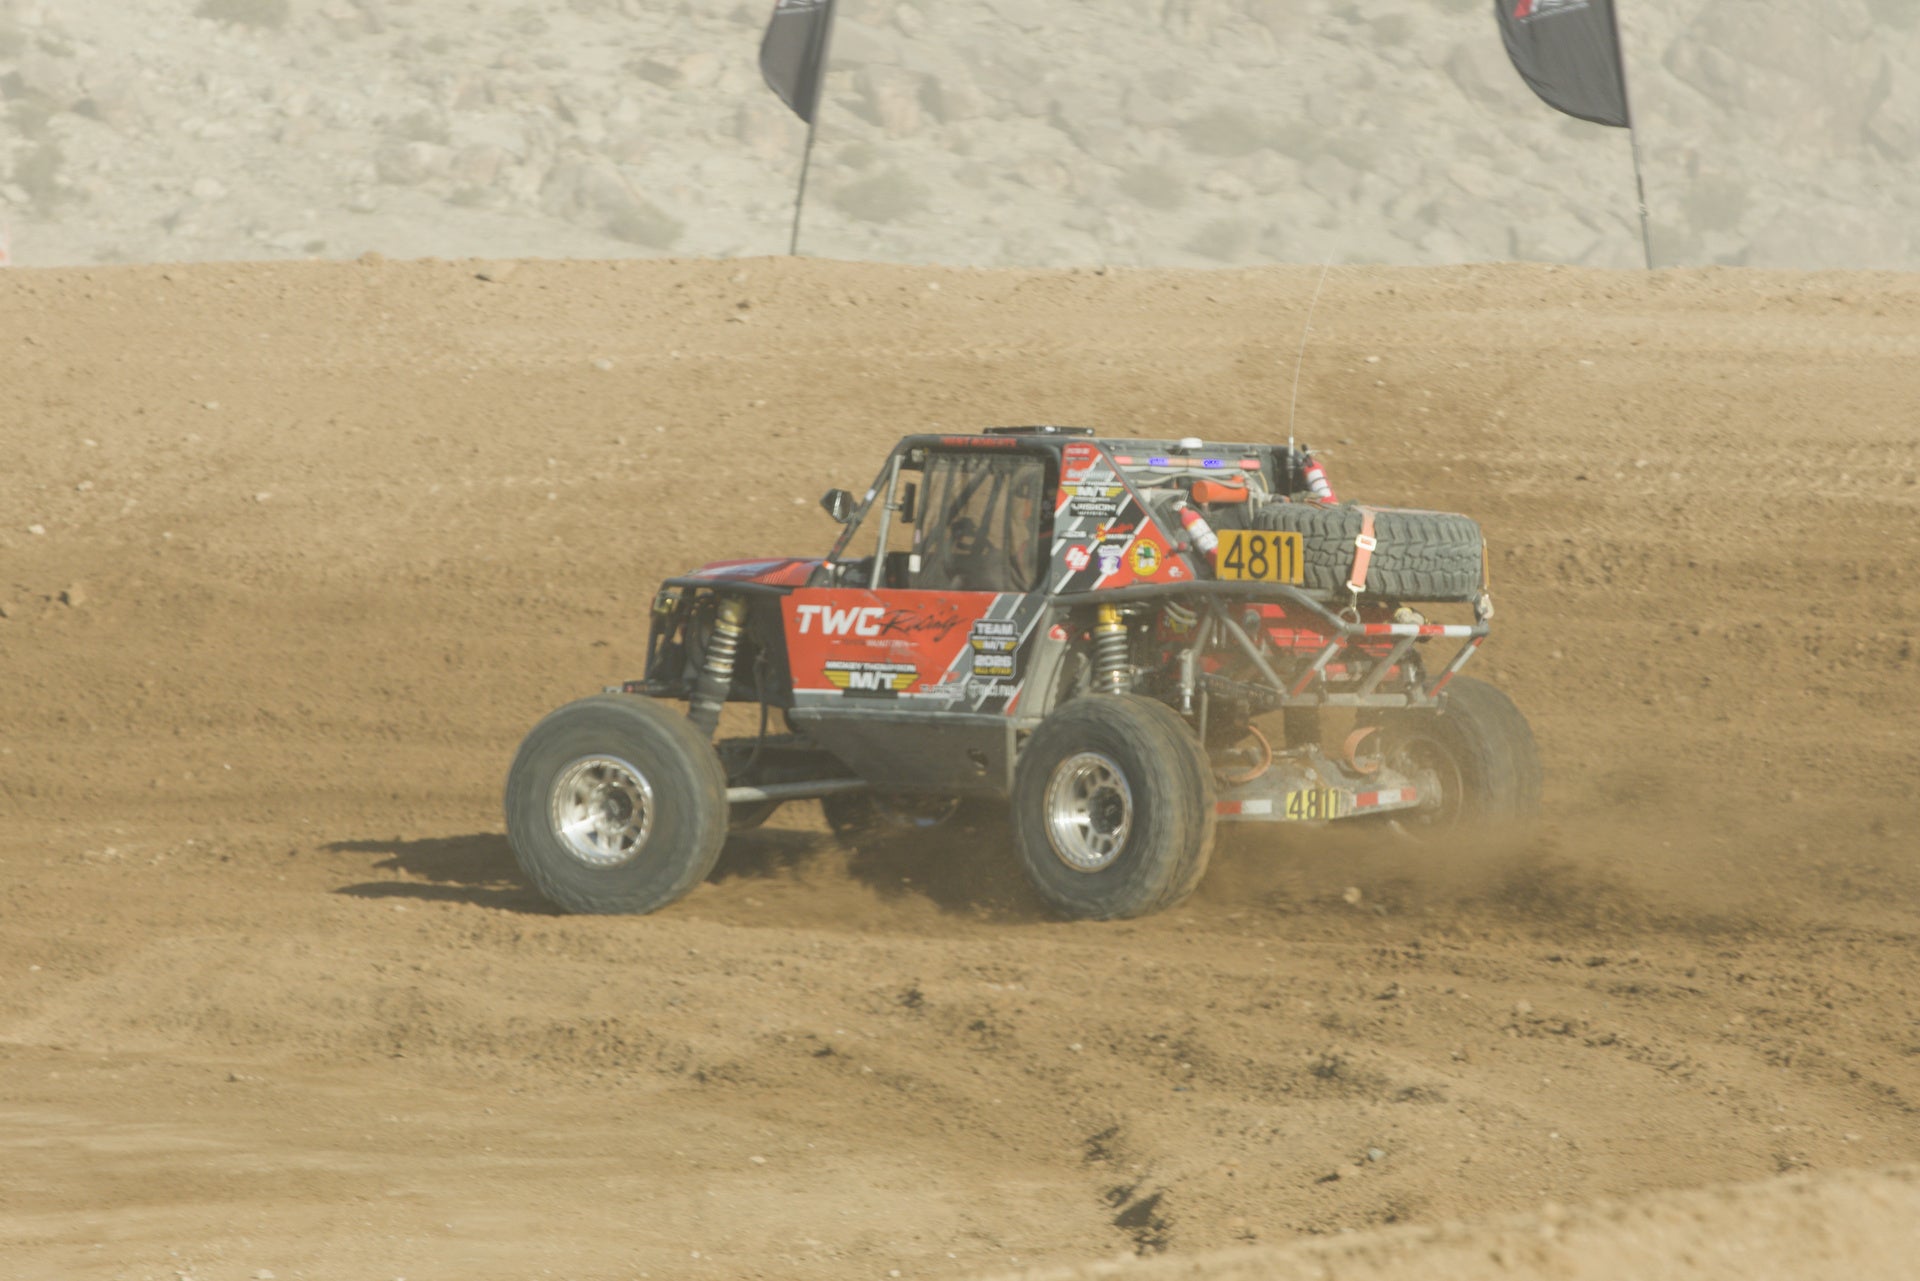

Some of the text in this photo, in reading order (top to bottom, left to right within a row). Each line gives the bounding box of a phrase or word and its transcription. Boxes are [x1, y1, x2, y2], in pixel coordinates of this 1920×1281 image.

[1223, 534, 1295, 580] 4811
[796, 604, 886, 636] TWC
[976, 623, 1014, 636] TEAM
[849, 671, 897, 691] M/T
[1288, 788, 1341, 820] 4811
